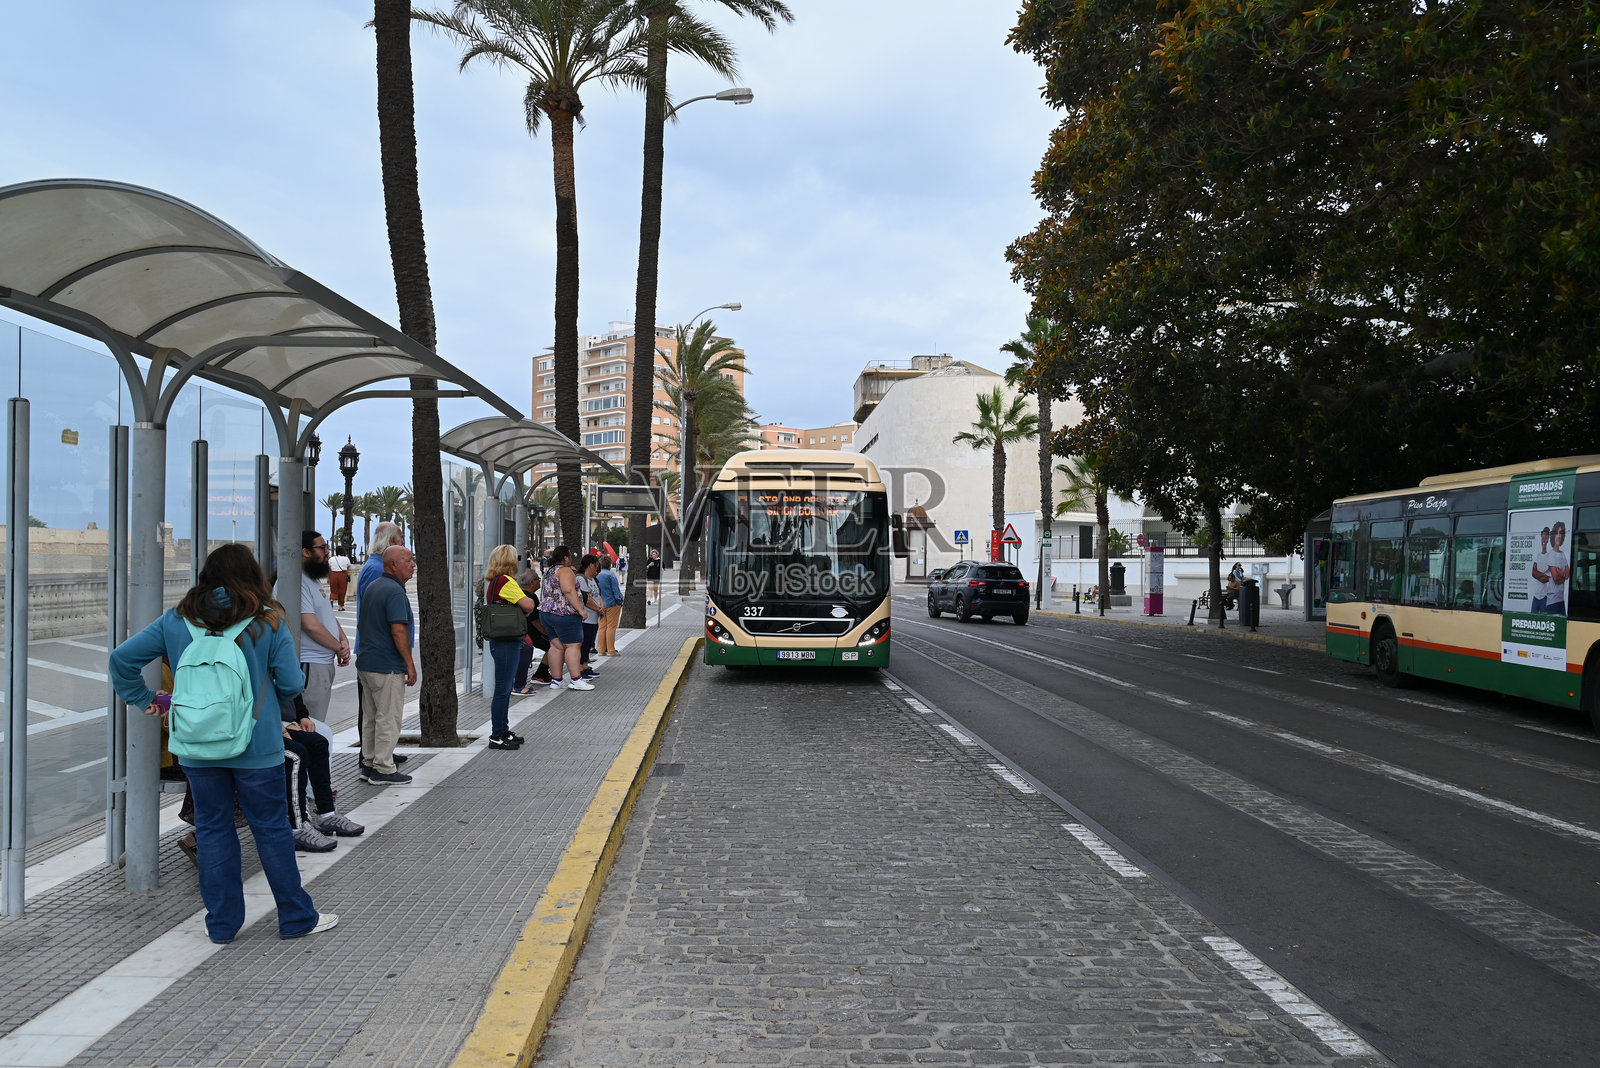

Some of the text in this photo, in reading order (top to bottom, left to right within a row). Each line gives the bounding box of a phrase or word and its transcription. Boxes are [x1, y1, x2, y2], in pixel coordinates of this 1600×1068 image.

[1408, 495, 1448, 511] Piso Bajo
[743, 606, 764, 617] 337
[781, 651, 799, 659] 9913
